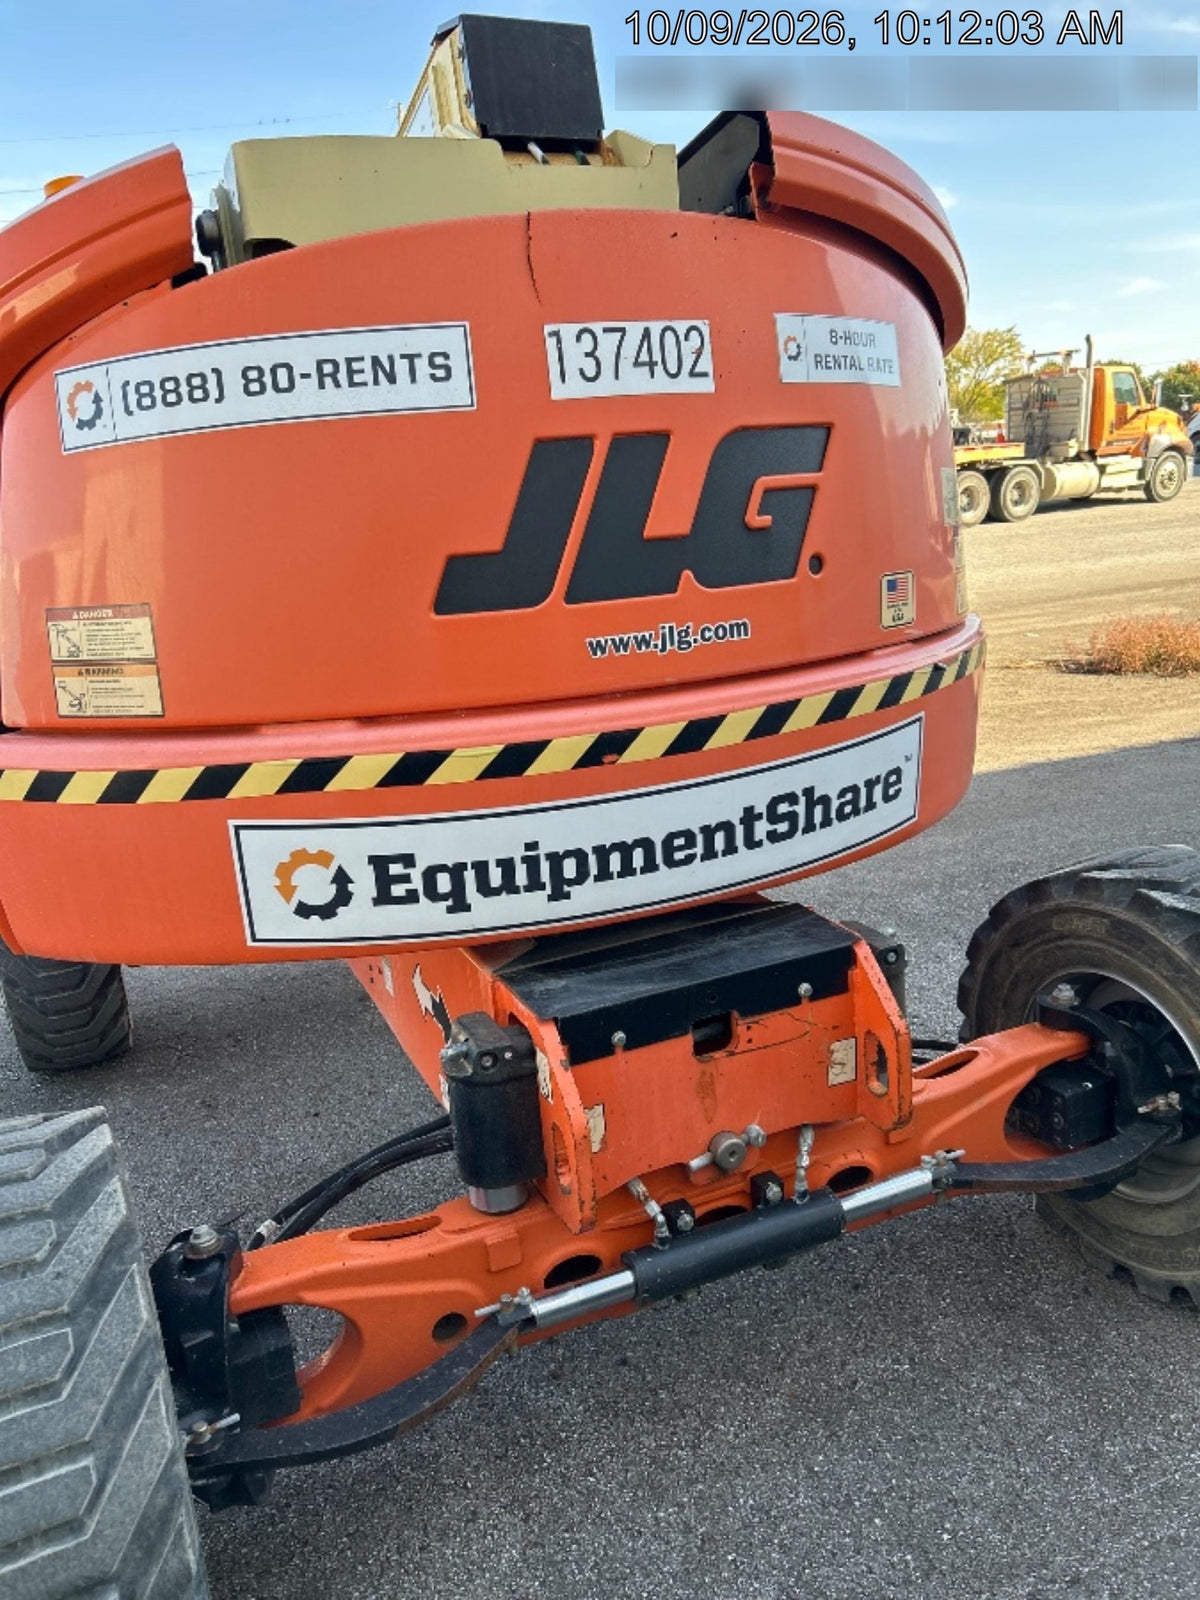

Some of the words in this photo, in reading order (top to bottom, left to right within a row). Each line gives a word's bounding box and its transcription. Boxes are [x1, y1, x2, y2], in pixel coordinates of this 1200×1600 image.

[547, 324, 709, 384] 137402
[813, 353, 864, 371] RENTAL
[866, 356, 895, 374] RATE
[829, 328, 877, 348] 8-HOUR
[121, 367, 225, 416] (888)
[242, 351, 453, 397] 80-RENTS
[432, 425, 833, 616] JLG
[586, 619, 750, 659] www.jlg.com
[367, 765, 903, 914] EquipmentShare
